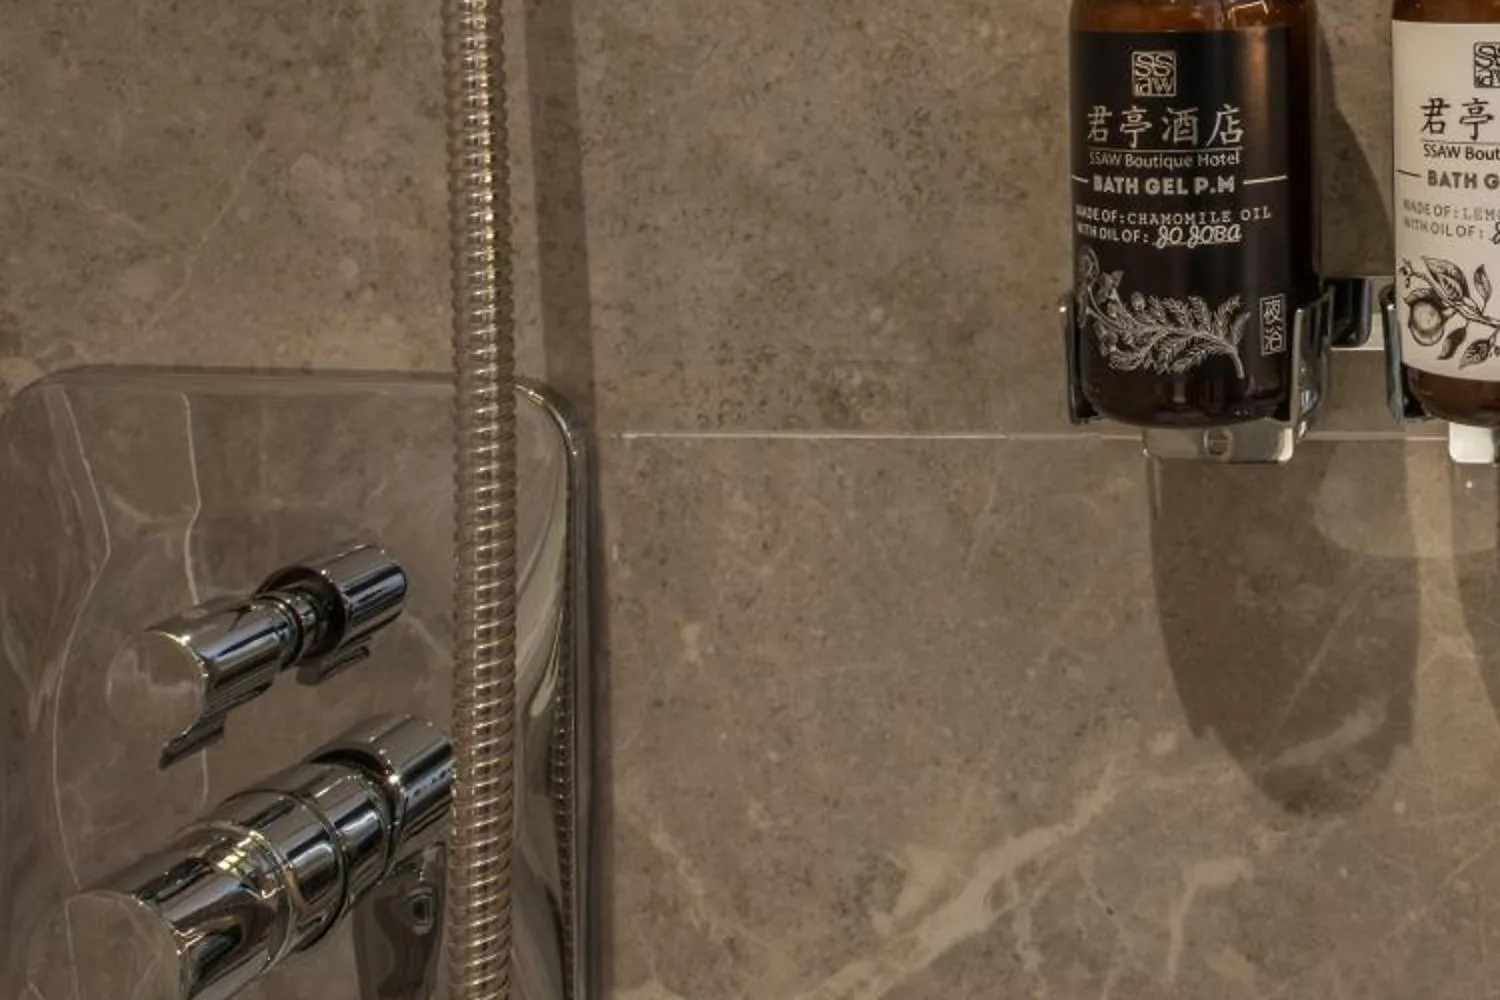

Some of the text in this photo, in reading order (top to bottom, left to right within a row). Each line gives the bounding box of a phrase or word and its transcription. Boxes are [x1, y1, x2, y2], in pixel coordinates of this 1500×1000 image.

[1087, 104, 1245, 148] 君亭酒店
[1090, 151, 1241, 170] SSAW Boutique Hotel
[1423, 144, 1460, 159] SSAW
[1093, 176, 1235, 195] BATH GEL P.M
[1428, 170, 1477, 188] BATH
[1128, 210, 1231, 225] CHAMOMILE
[1241, 205, 1271, 220] OIL
[1100, 227, 1121, 241] OIL
[1432, 222, 1455, 237] OIL
